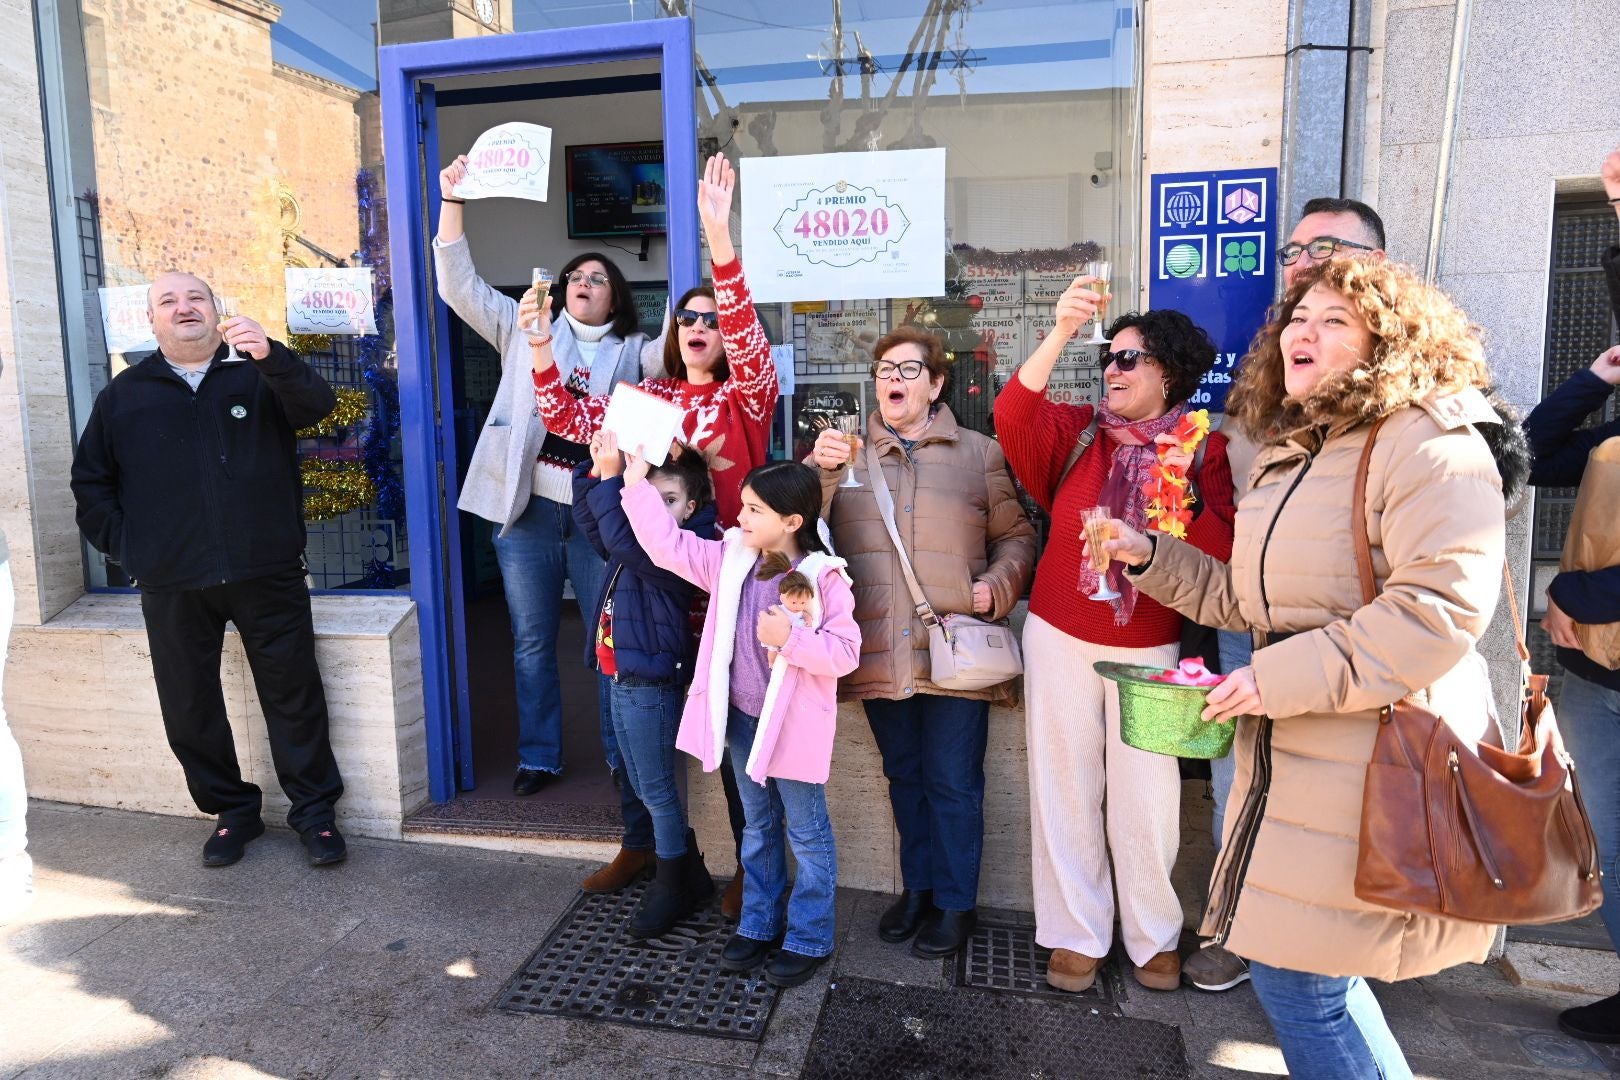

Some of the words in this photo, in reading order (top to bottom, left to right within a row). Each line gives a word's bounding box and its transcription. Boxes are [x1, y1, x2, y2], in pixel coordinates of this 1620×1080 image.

[474, 148, 530, 169] 48020
[825, 195, 866, 206] PREMIO
[794, 208, 888, 239] 48020
[812, 239, 848, 247] VENDIDO
[850, 237, 871, 247] AQUÍ
[301, 290, 357, 310] 48020
[994, 293, 1013, 302] AQUÍ
[982, 319, 1013, 327] PREMIO
[1072, 355, 1092, 363] AQUÍ
[1226, 353, 1236, 367] y
[1200, 370, 1232, 384] stas
[1058, 382, 1092, 390] PREMIO
